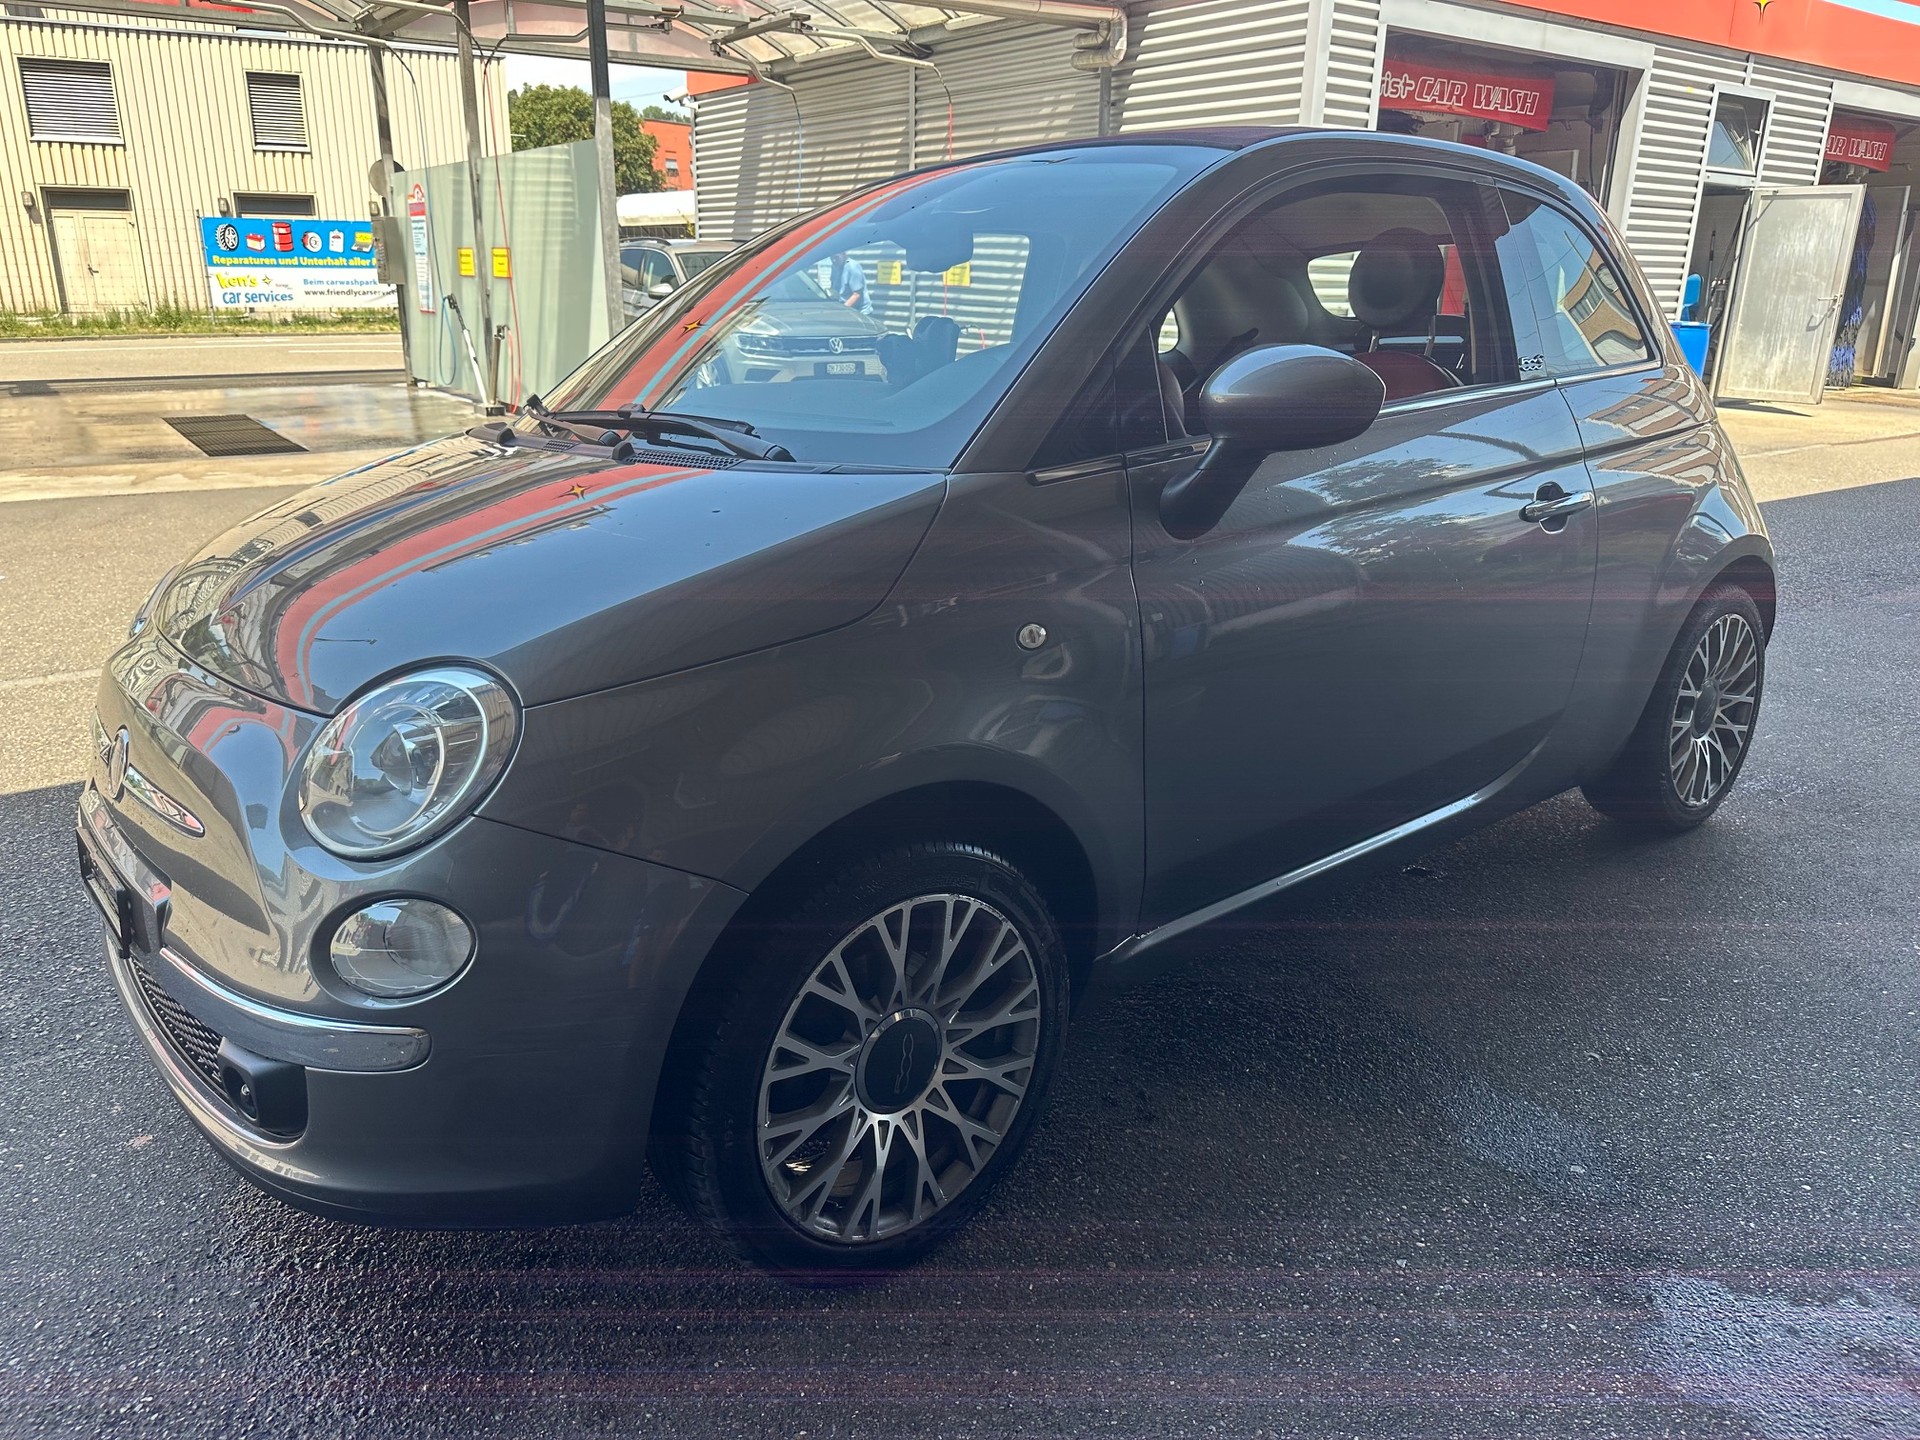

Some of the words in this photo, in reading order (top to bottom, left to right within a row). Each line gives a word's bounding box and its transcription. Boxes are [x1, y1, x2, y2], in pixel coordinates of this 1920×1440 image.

[1415, 76, 1468, 107] CAR
[1473, 83, 1540, 116] WASH
[1848, 138, 1888, 160] WASH
[212, 255, 277, 266] Reparaturen
[278, 256, 298, 266] und
[300, 256, 348, 266] Unterhalt
[348, 256, 371, 266] aller
[215, 271, 258, 290] ken's
[326, 279, 378, 287] carwashpark
[222, 291, 241, 304] car
[244, 290, 294, 303] services
